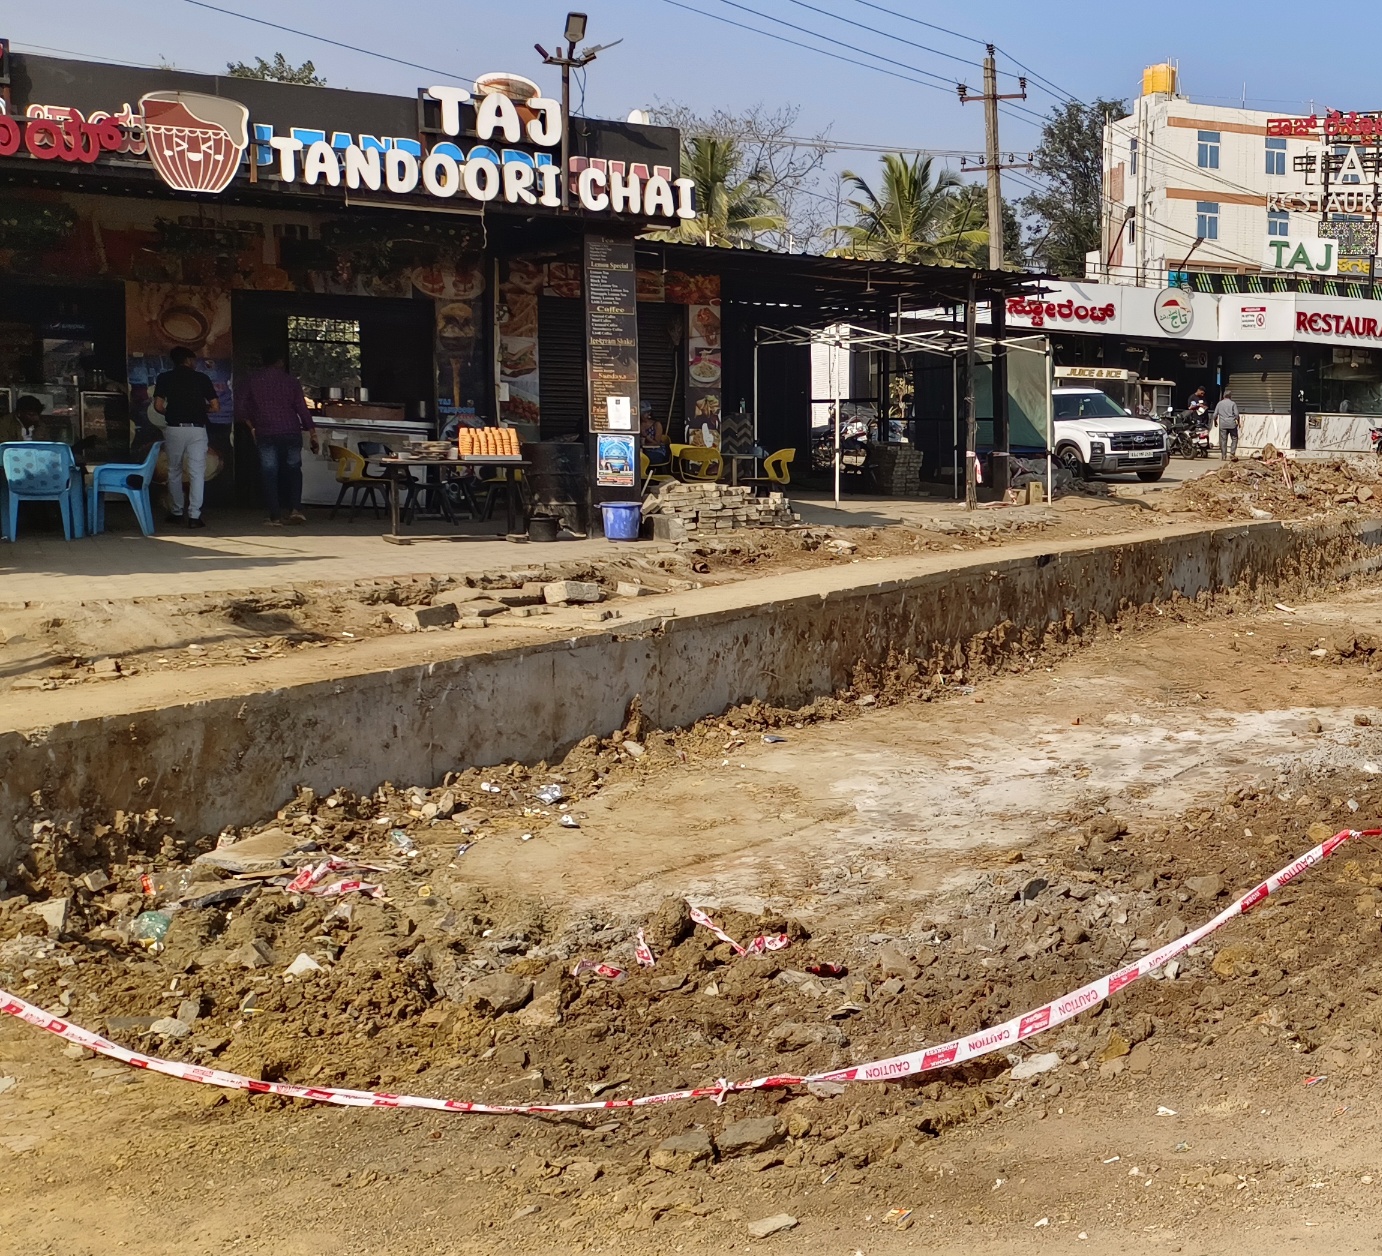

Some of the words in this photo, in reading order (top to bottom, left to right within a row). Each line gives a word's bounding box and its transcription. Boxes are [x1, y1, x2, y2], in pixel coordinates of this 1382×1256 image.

[428, 85, 562, 146] TAJ
[270, 136, 561, 207] TANDOORI
[578, 167, 697, 219] CHAI
[1269, 240, 1333, 272] TAJ
[597, 305, 625, 313] Coffee
[1005, 295, 1115, 328] ಸ್ಟೋರೆಂಟ್
[1067, 368, 1095, 377] JUICE
[1096, 369, 1103, 378] &
[1106, 370, 1122, 378] ICE
[1277, 854, 1315, 886] CAUTION
[1057, 988, 1098, 1016] CAUTION
[968, 1029, 1010, 1053] CAUTION
[865, 1060, 910, 1079] CAUTION
